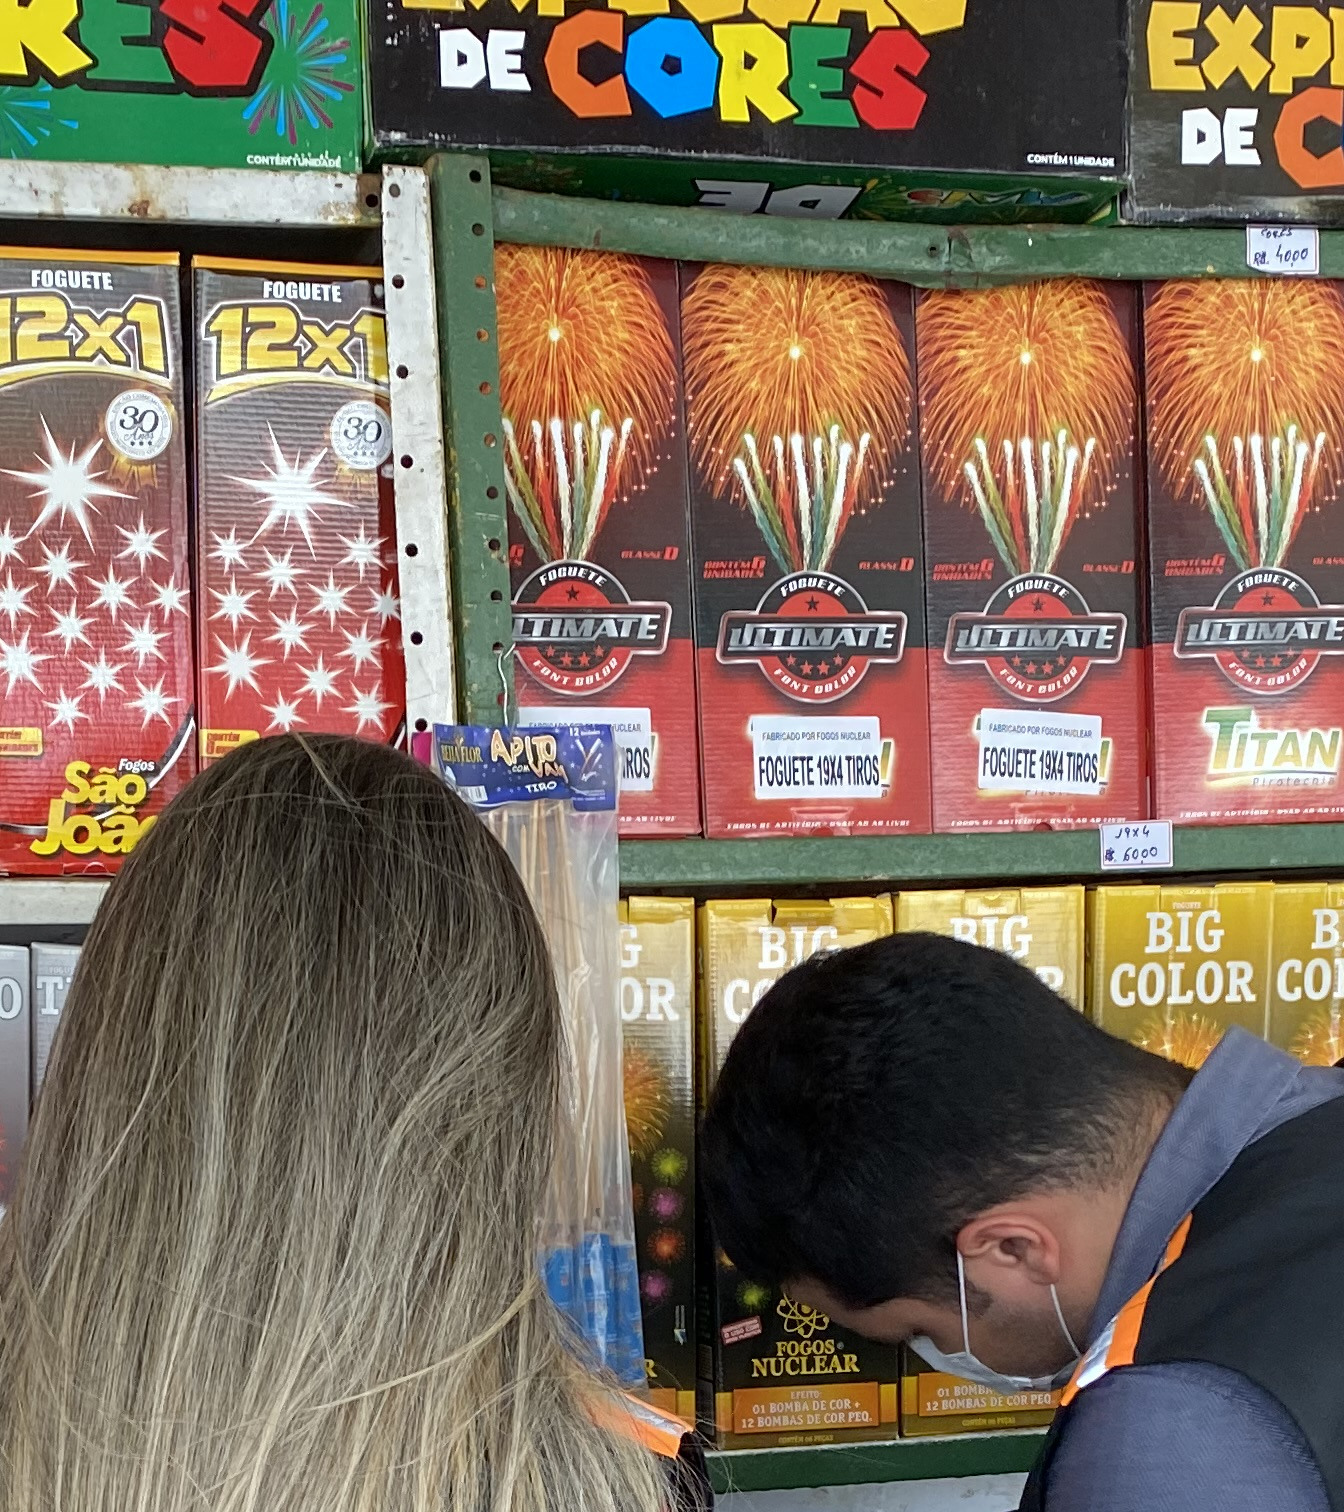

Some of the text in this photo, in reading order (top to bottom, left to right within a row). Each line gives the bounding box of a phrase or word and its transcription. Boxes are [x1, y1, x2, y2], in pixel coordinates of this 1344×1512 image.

[439, 9, 930, 130] DE CORES
[1181, 106, 1261, 166] DE
[31, 268, 114, 292] FOGUETE
[262, 280, 342, 303] FOGUETE
[512, 615, 659, 642] LTIMATE
[728, 622, 898, 652] ULTIMATE
[955, 623, 1114, 652] ULTIMATE
[491, 729, 558, 766] APITO
[762, 731, 872, 742] FABRICADO POR FOGOS NUCLEAR
[1203, 709, 1339, 771] TITAN
[512, 765, 530, 773] COM
[758, 753, 880, 788] FOGUETE 19X4 TIROS
[981, 746, 1098, 785] FOGUETE 19X4 TIROS
[62, 759, 148, 806] São
[525, 781, 557, 793] TIRO
[1122, 846, 1158, 864] 60,00
[1145, 911, 1225, 953] BIG
[1110, 959, 1256, 1007] COLOR
[776, 1339, 836, 1358] FOGOS
[751, 1352, 860, 1379] NUCLEAR
[742, 1416, 754, 1429] 12
[756, 1414, 803, 1428] BOMBAS
[821, 1412, 844, 1425] COR
[752, 1399, 851, 1415] 01 BOMBA COR
